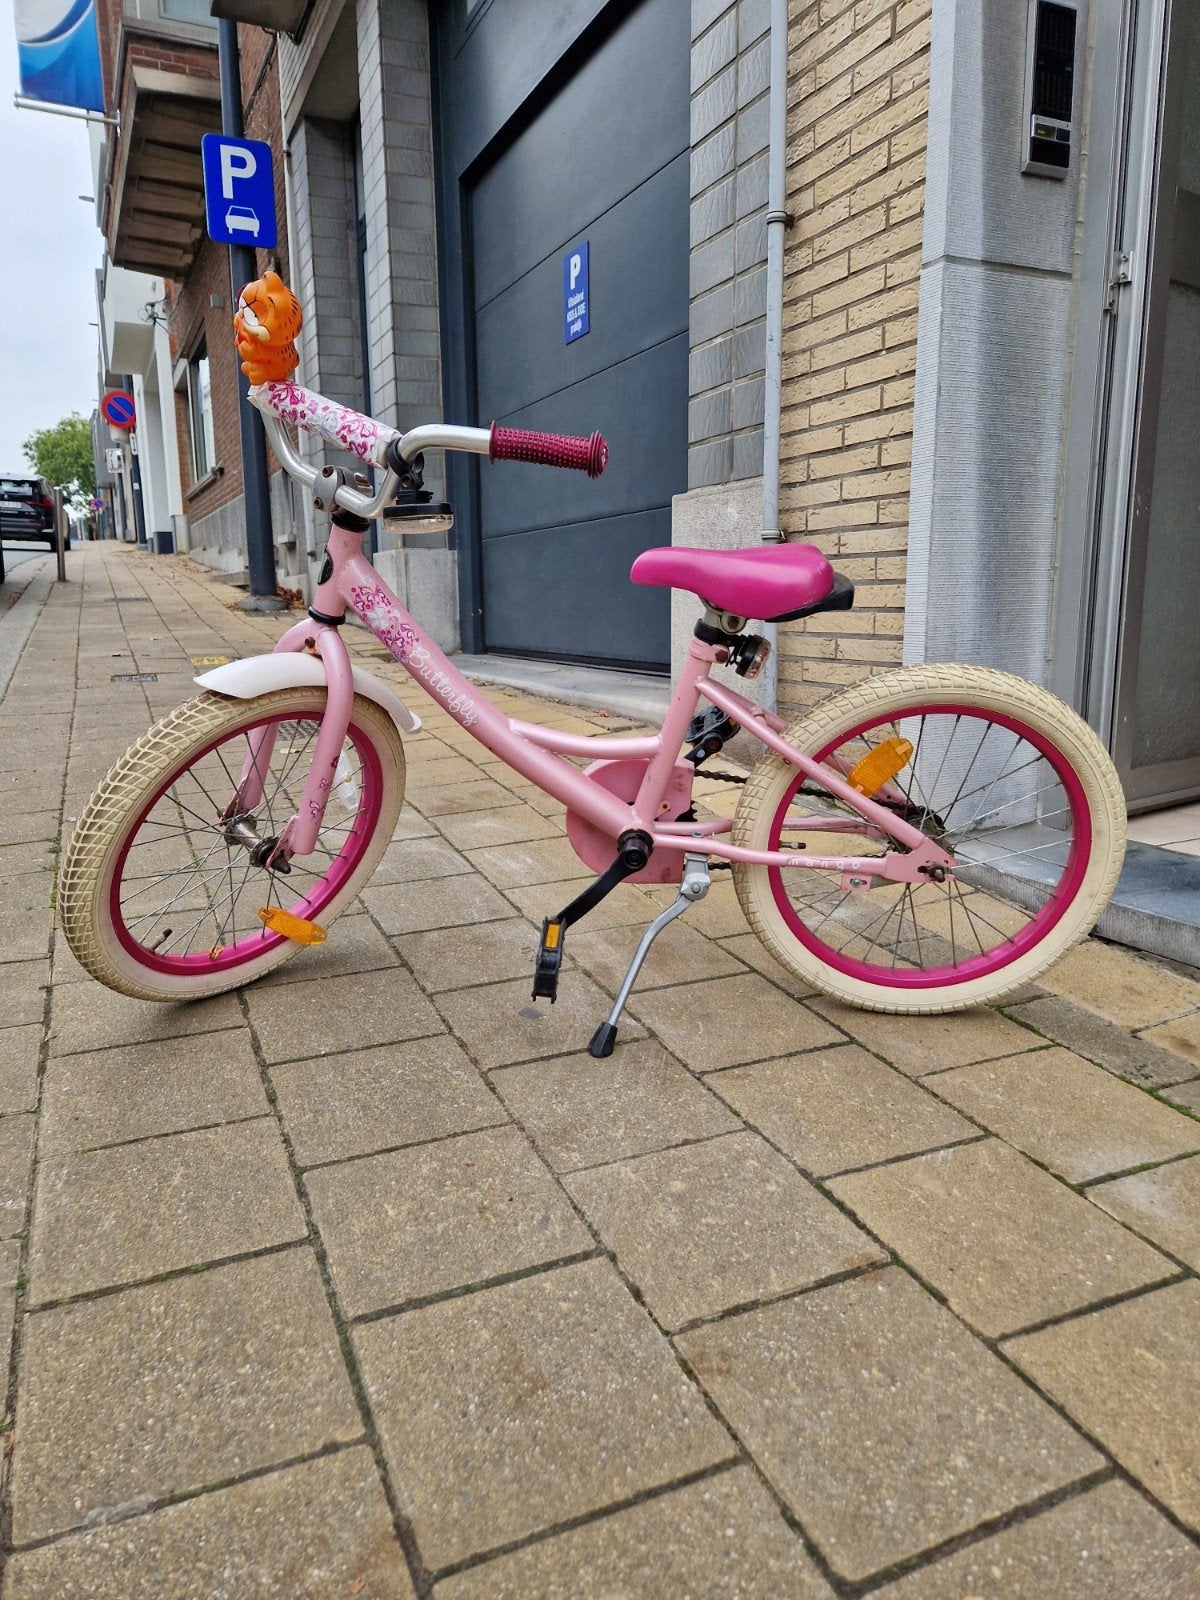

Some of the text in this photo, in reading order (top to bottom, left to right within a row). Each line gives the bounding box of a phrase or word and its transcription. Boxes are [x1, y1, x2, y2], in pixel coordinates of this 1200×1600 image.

[220, 144, 257, 199] P
[570, 254, 581, 290] P
[409, 646, 478, 726] Butterfly
[788, 858, 860, 871] mango
